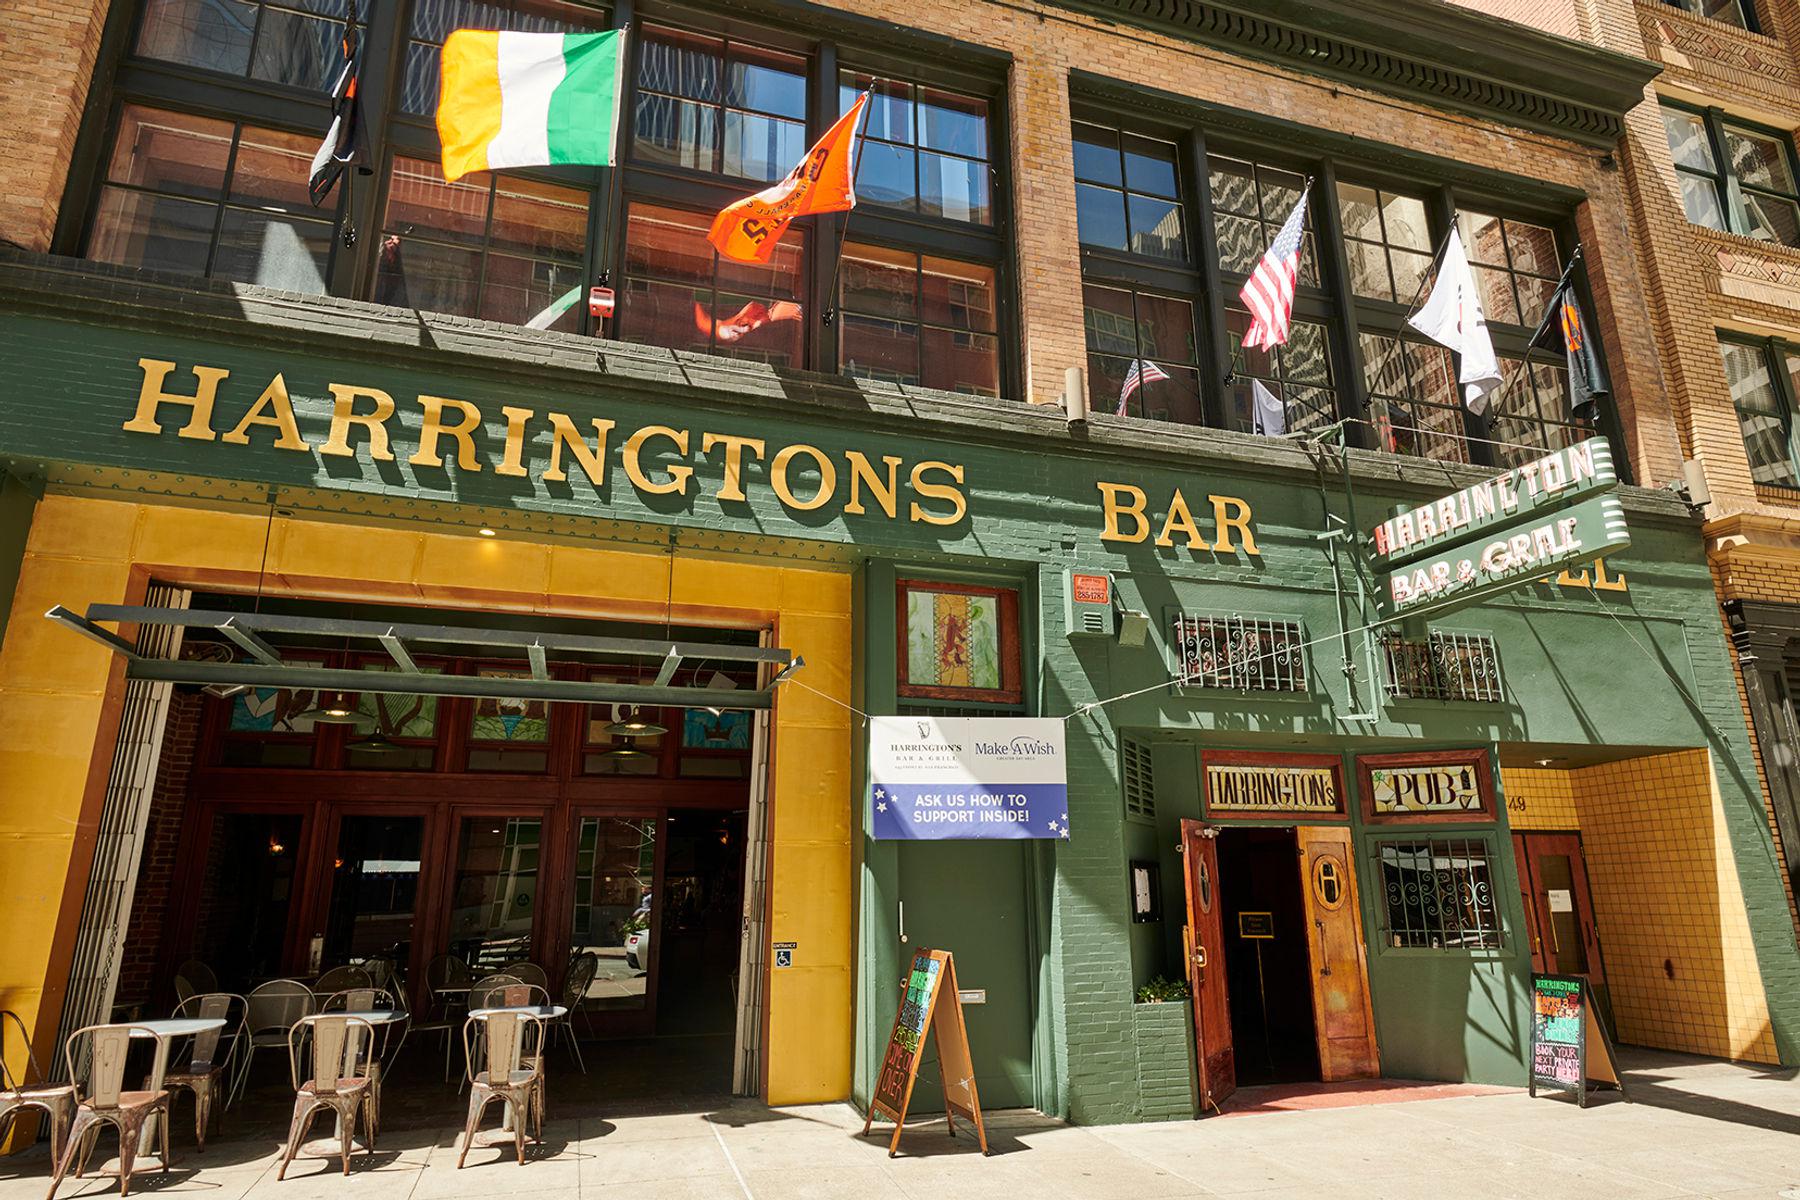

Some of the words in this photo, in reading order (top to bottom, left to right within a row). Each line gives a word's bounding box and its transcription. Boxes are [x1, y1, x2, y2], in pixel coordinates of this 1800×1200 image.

[122, 357, 968, 526] HARRINGTONS
[1096, 481, 1261, 555] BAR
[1390, 560, 1455, 603] BAR
[1456, 559, 1478, 584] &
[890, 744, 963, 752] HARRINGTON'S
[975, 741, 1009, 755] Make
[1023, 740, 1056, 755] Wish
[1393, 772, 1457, 807] PUB
[915, 795, 943, 807] ASK
[946, 795, 966, 807] US
[970, 795, 1004, 807] HOW
[1008, 795, 1027, 807] TO
[913, 810, 975, 823] SUPPORT
[980, 810, 1030, 823] INSIDE!
[1556, 1047, 1578, 1059] YOUR
